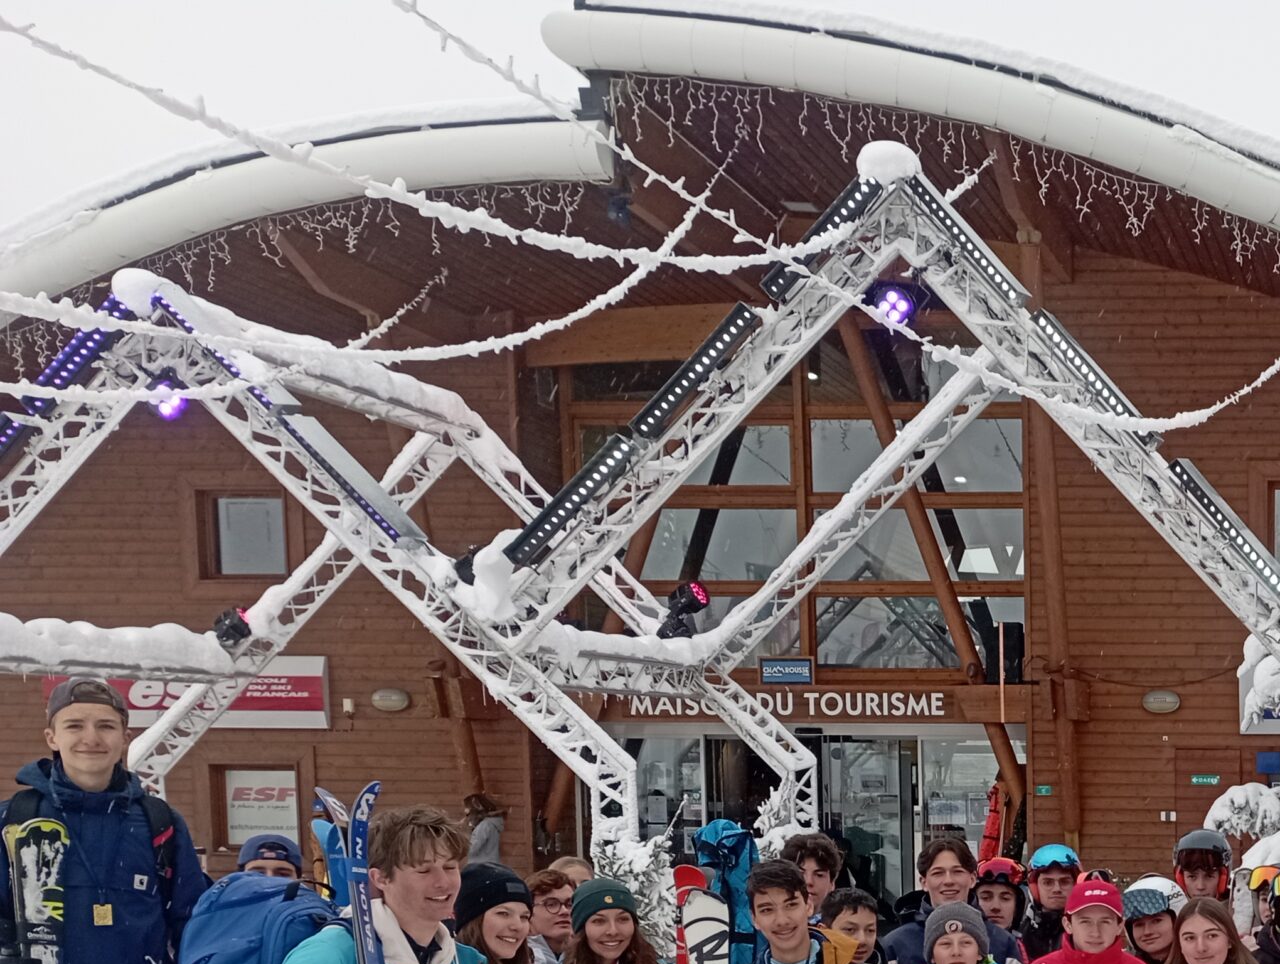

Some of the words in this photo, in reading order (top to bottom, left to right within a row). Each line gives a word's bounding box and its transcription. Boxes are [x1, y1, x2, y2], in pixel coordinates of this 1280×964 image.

[756, 692, 793, 715] DU
[804, 692, 945, 716] TOURISME
[231, 787, 296, 802] ESF
